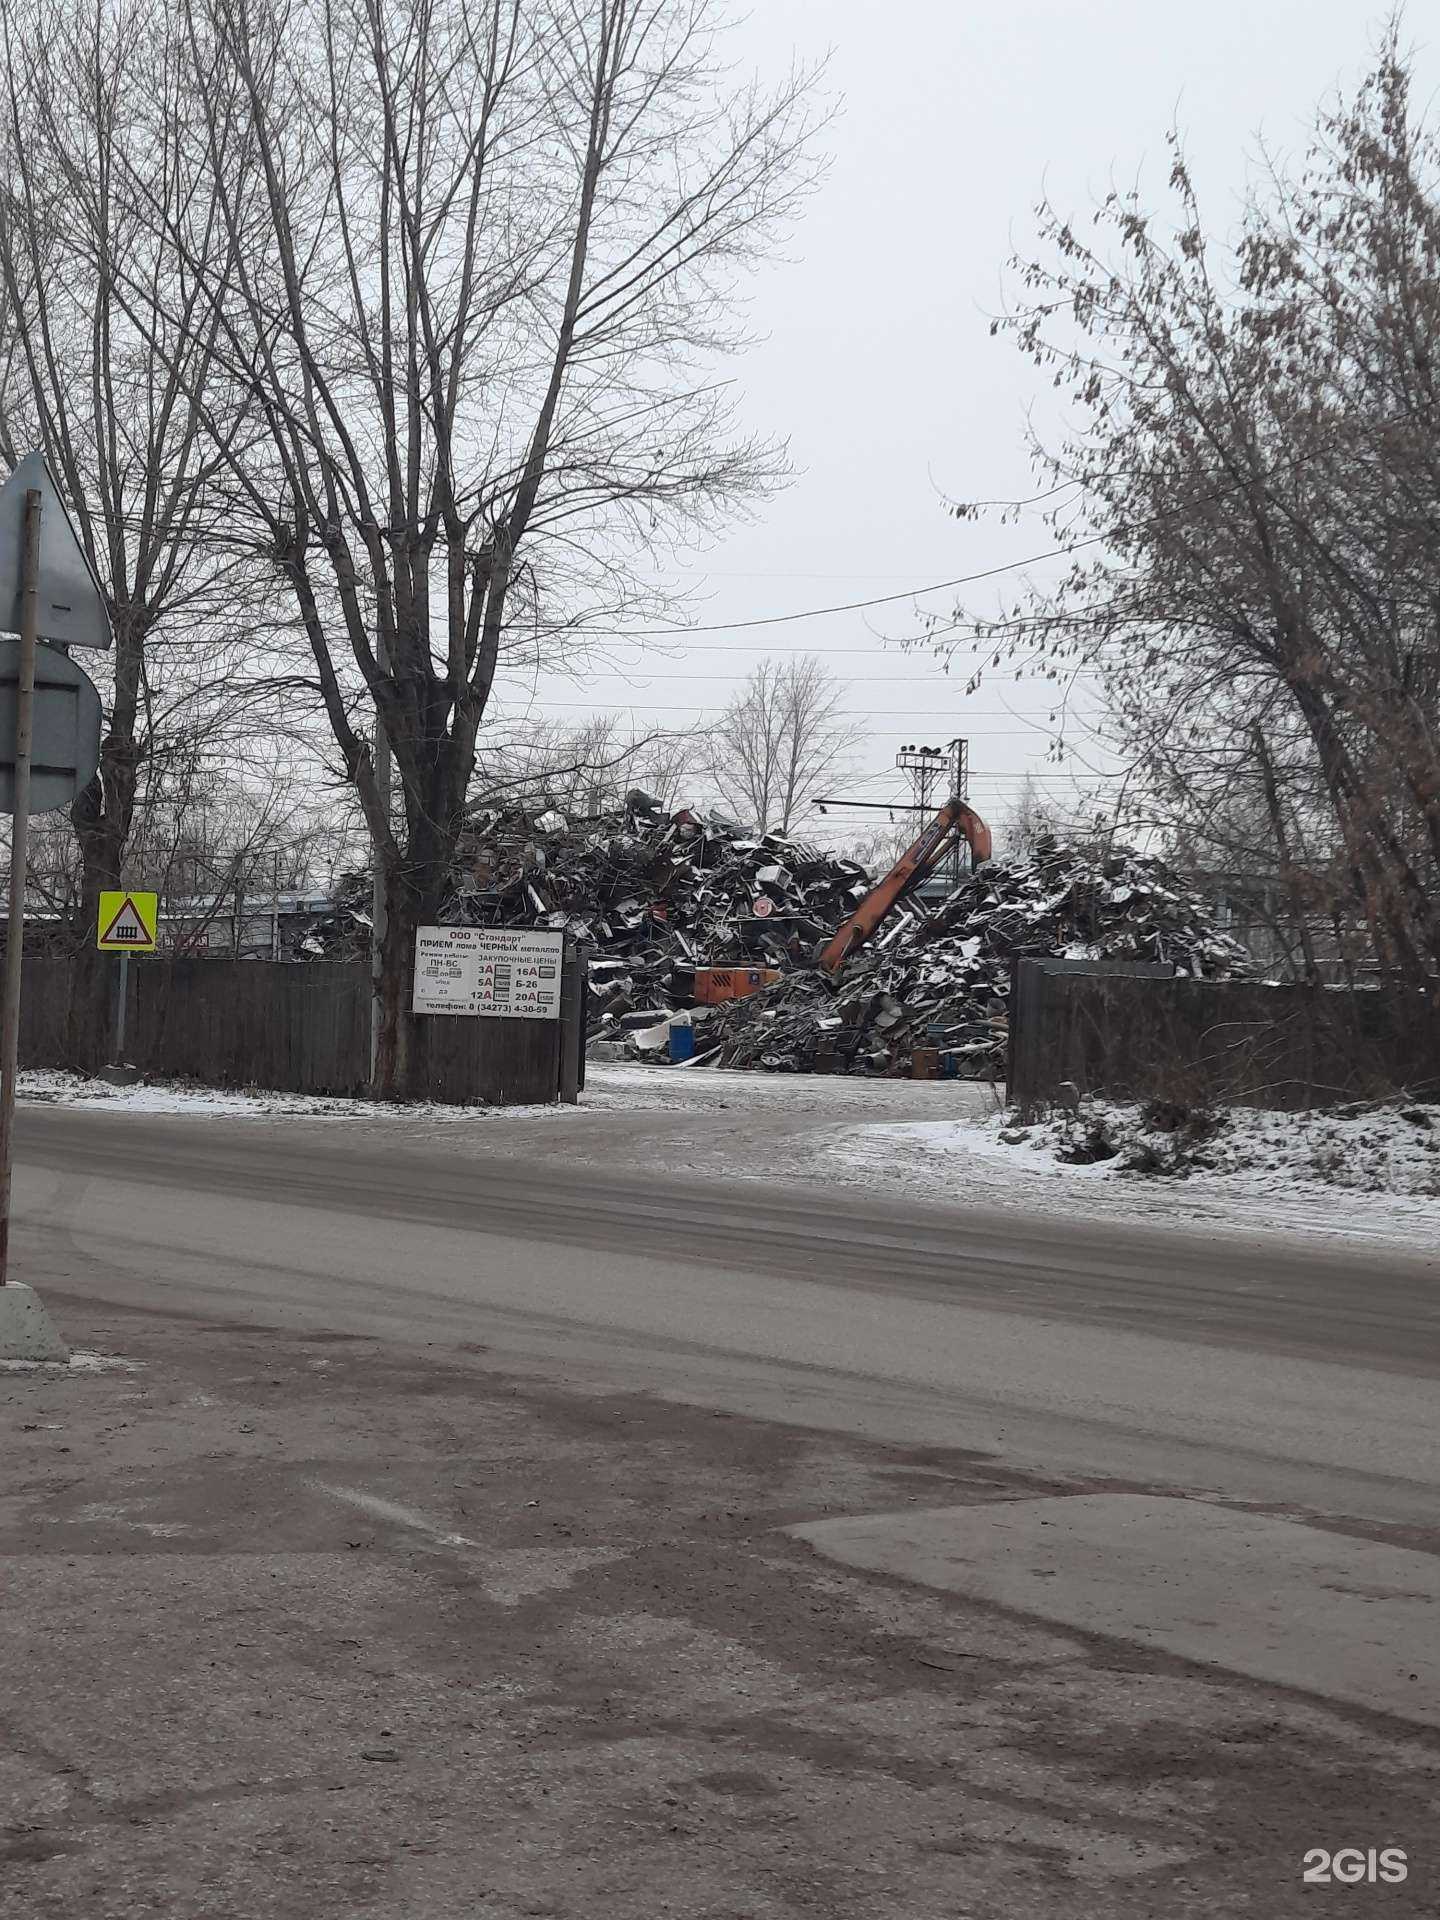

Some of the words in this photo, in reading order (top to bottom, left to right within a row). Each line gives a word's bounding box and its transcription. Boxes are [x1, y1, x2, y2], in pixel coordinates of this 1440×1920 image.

[450, 931, 471, 940] ООО
[474, 932, 526, 944] "Стандарт"
[420, 939, 453, 949] ПРИЕМ
[480, 943, 518, 952] ЧЕРНЫХ
[520, 946, 560, 954] металлов
[430, 959, 458, 968] ПН-ВС
[478, 954, 533, 964] ЗАКУПОЧНЫЕ
[533, 957, 557, 965] ЦЕНЫ
[517, 967, 538, 977] 16А
[515, 980, 538, 989] Б-26
[471, 990, 492, 1000] 12А
[515, 992, 536, 1001] 20А
[477, 1004, 512, 1013] (34273)
[513, 1005, 548, 1013] 4-30-59
